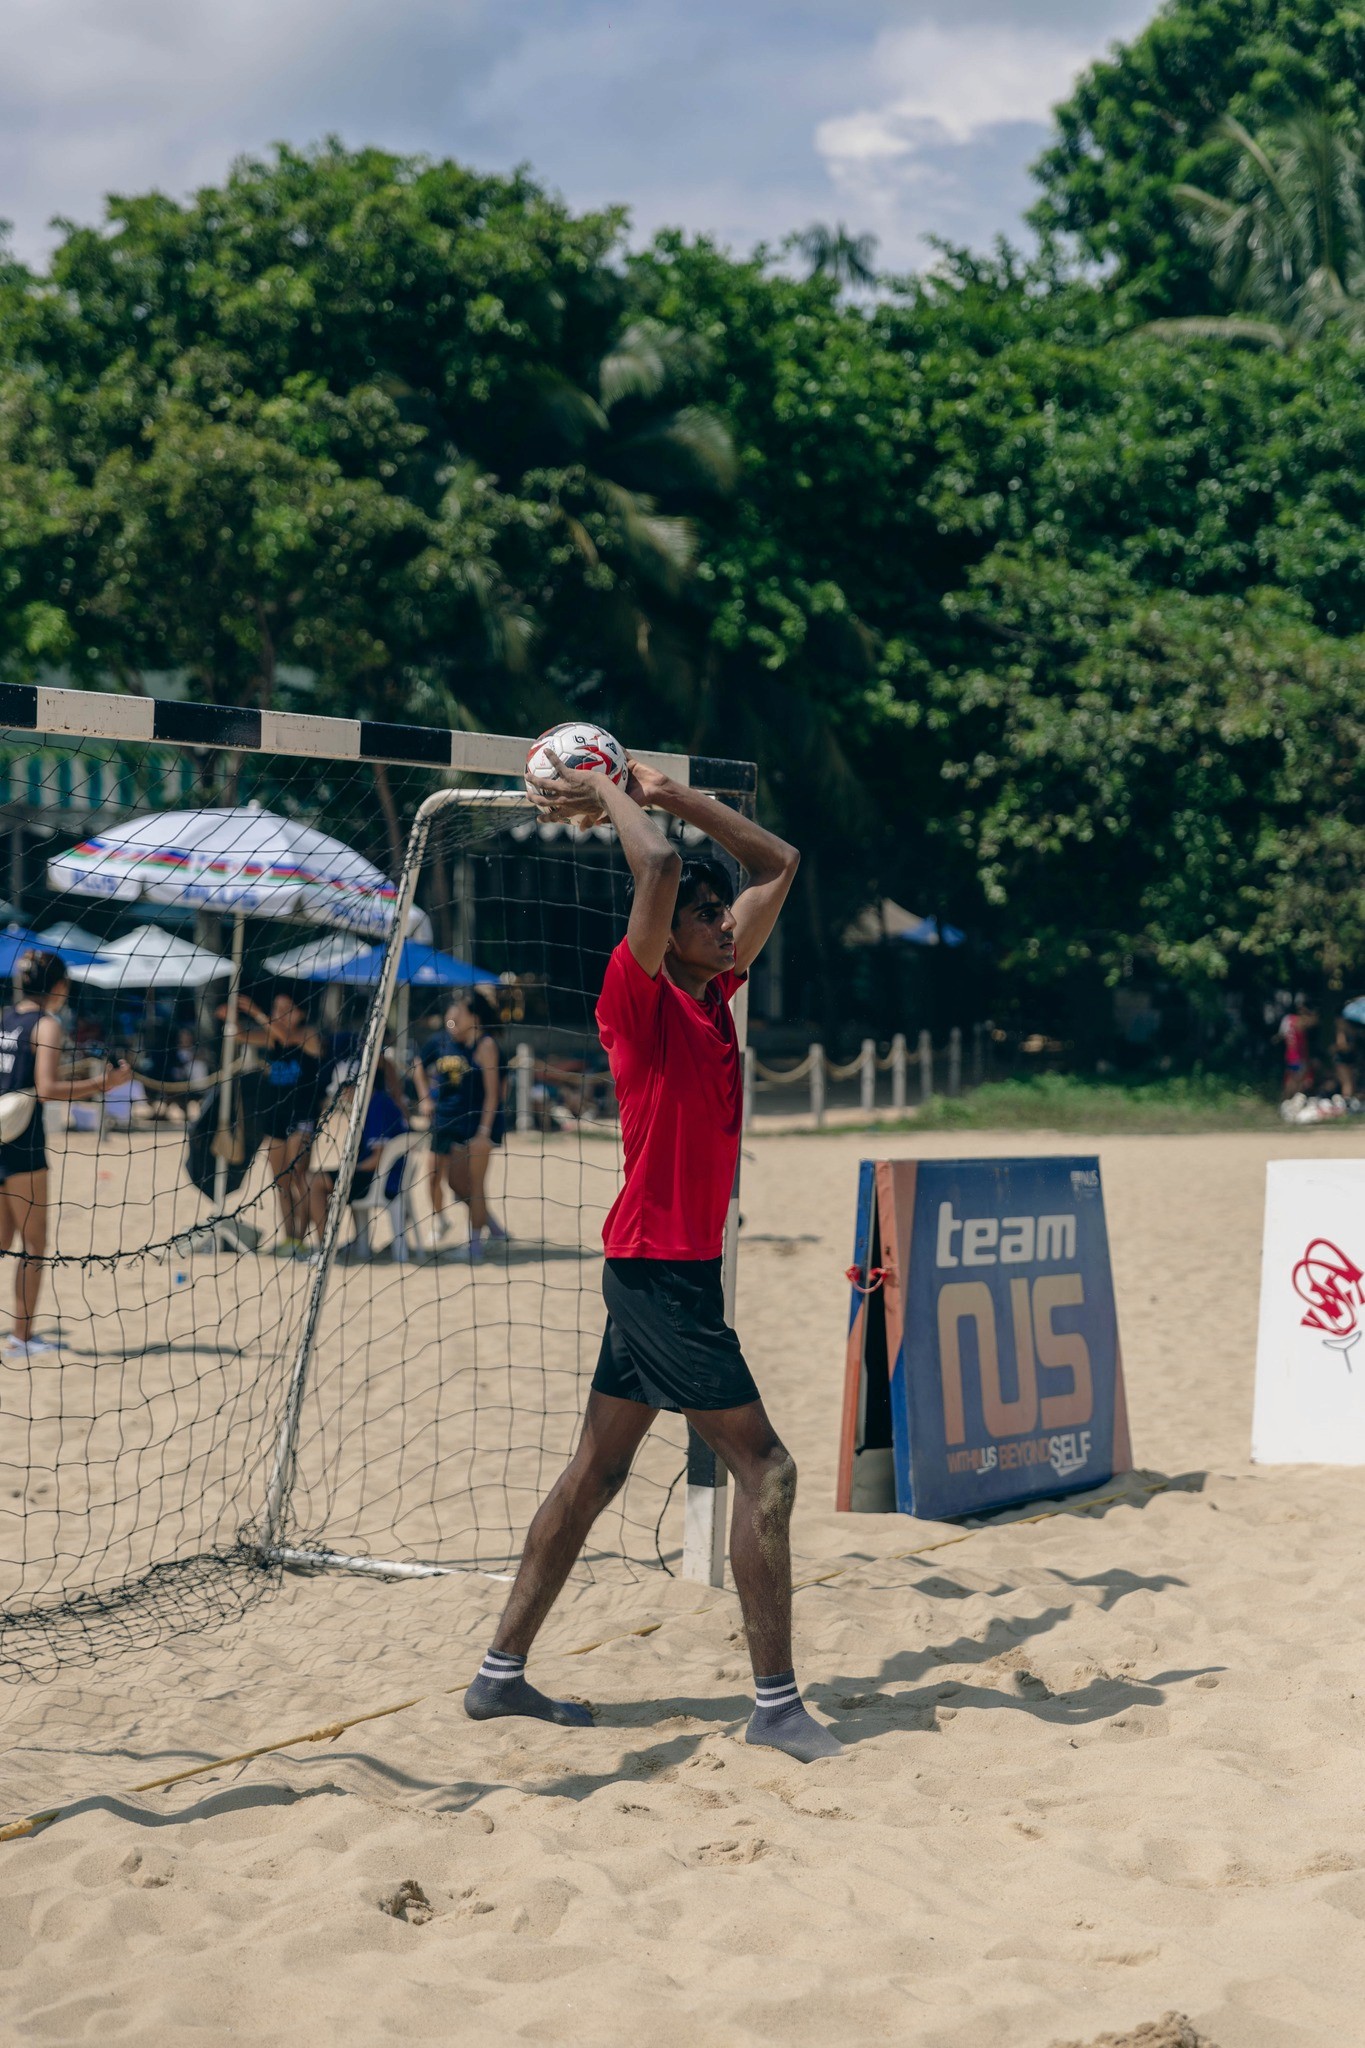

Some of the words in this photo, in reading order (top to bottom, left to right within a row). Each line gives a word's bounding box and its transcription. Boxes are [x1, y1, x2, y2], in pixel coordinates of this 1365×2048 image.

[184, 885, 257, 908] PLUS
[936, 1201, 1076, 1269] team
[938, 1273, 1093, 1446] NUS
[1049, 1430, 1091, 1470] SELF
